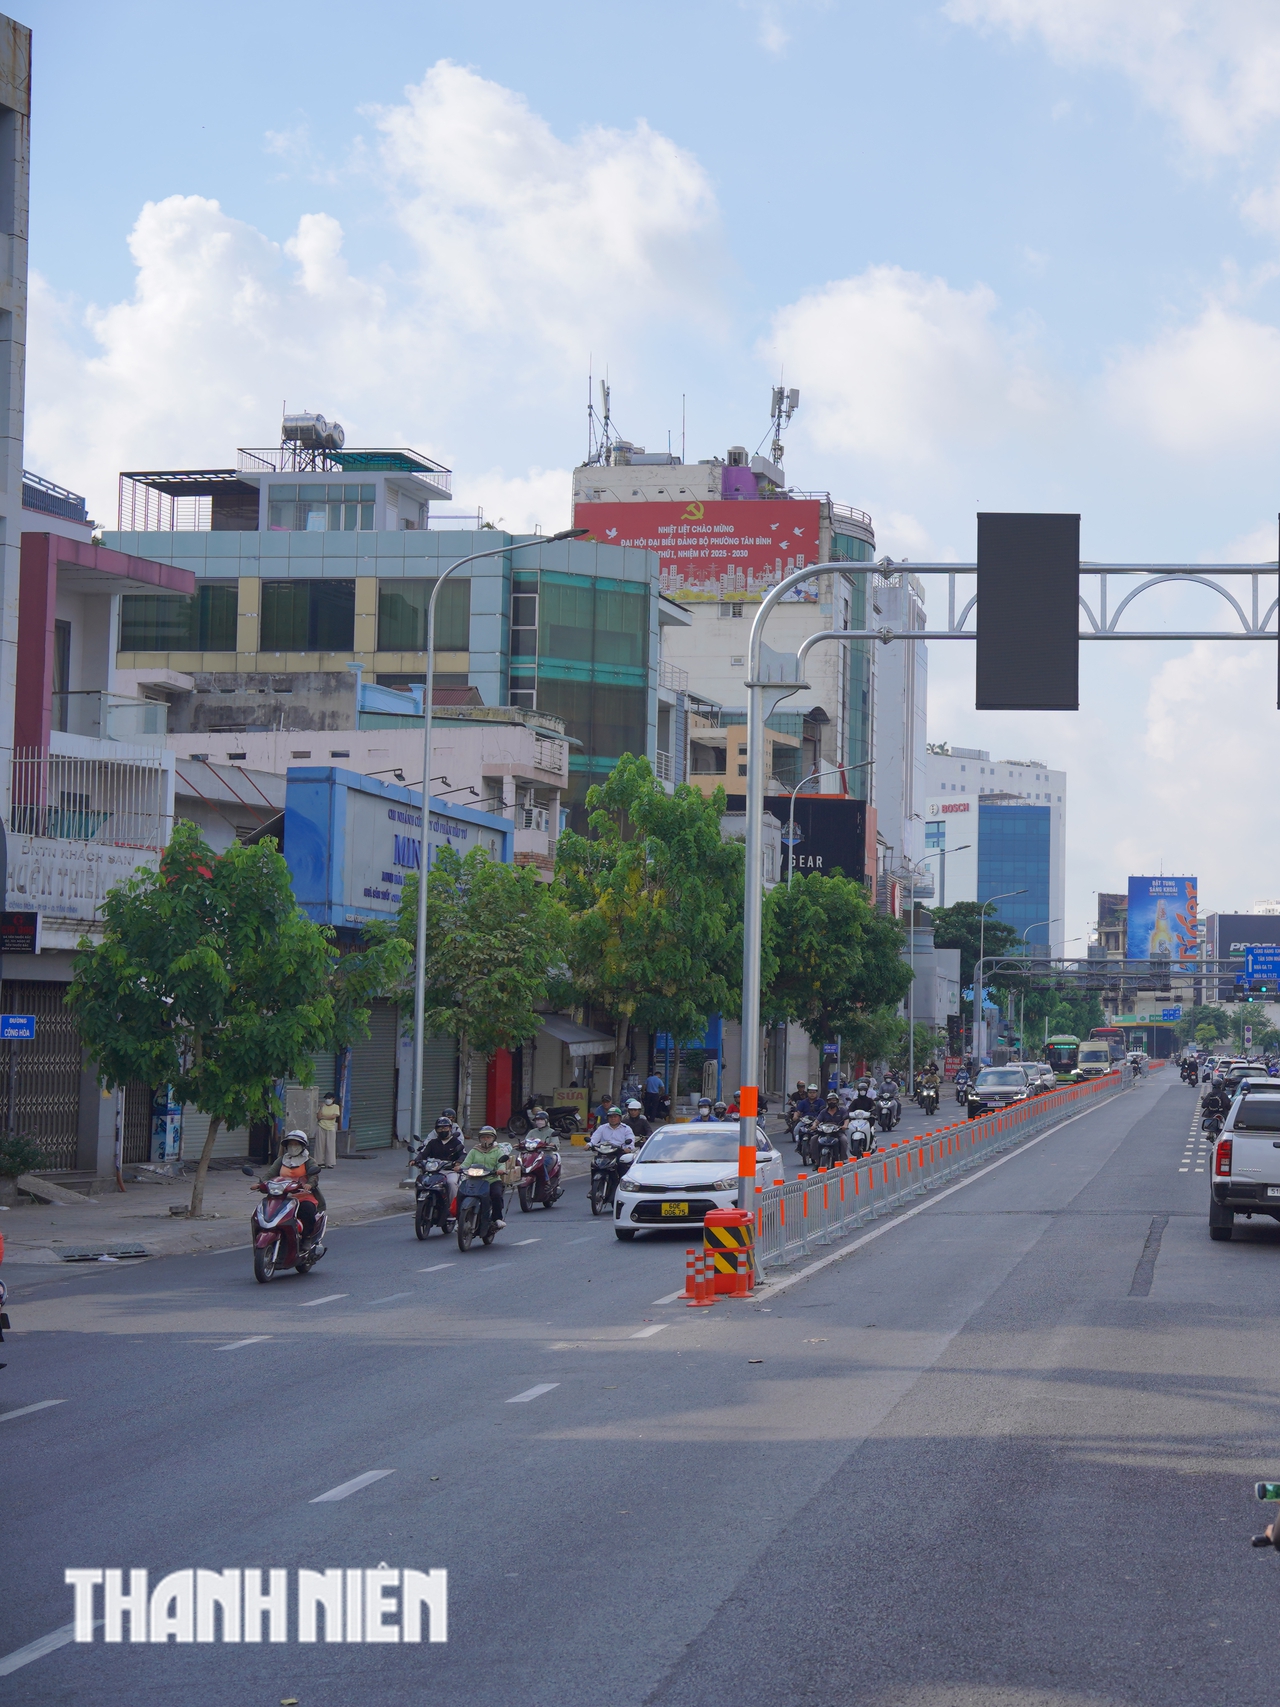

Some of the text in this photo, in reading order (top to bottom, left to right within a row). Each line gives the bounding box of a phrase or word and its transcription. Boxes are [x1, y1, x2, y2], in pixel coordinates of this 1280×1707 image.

[658, 522, 734, 536] NHIỆT LIỆT CHÀO MỪNG
[620, 535, 772, 548] ĐẠI HỘI ĐẠI BIỂU ĐẢNG BỘ PHƯỜNG TÂN BÌNH
[678, 549, 699, 560] NHIỆM
[700, 548, 710, 558] KỲ
[711, 550, 727, 558] 2025
[732, 550, 748, 558] 2030
[941, 803, 970, 814] BOSCH
[791, 855, 823, 868] GEAR
[5, 859, 53, 900] HUẬN
[4, 1026, 30, 1038] CỘNG HÒA
